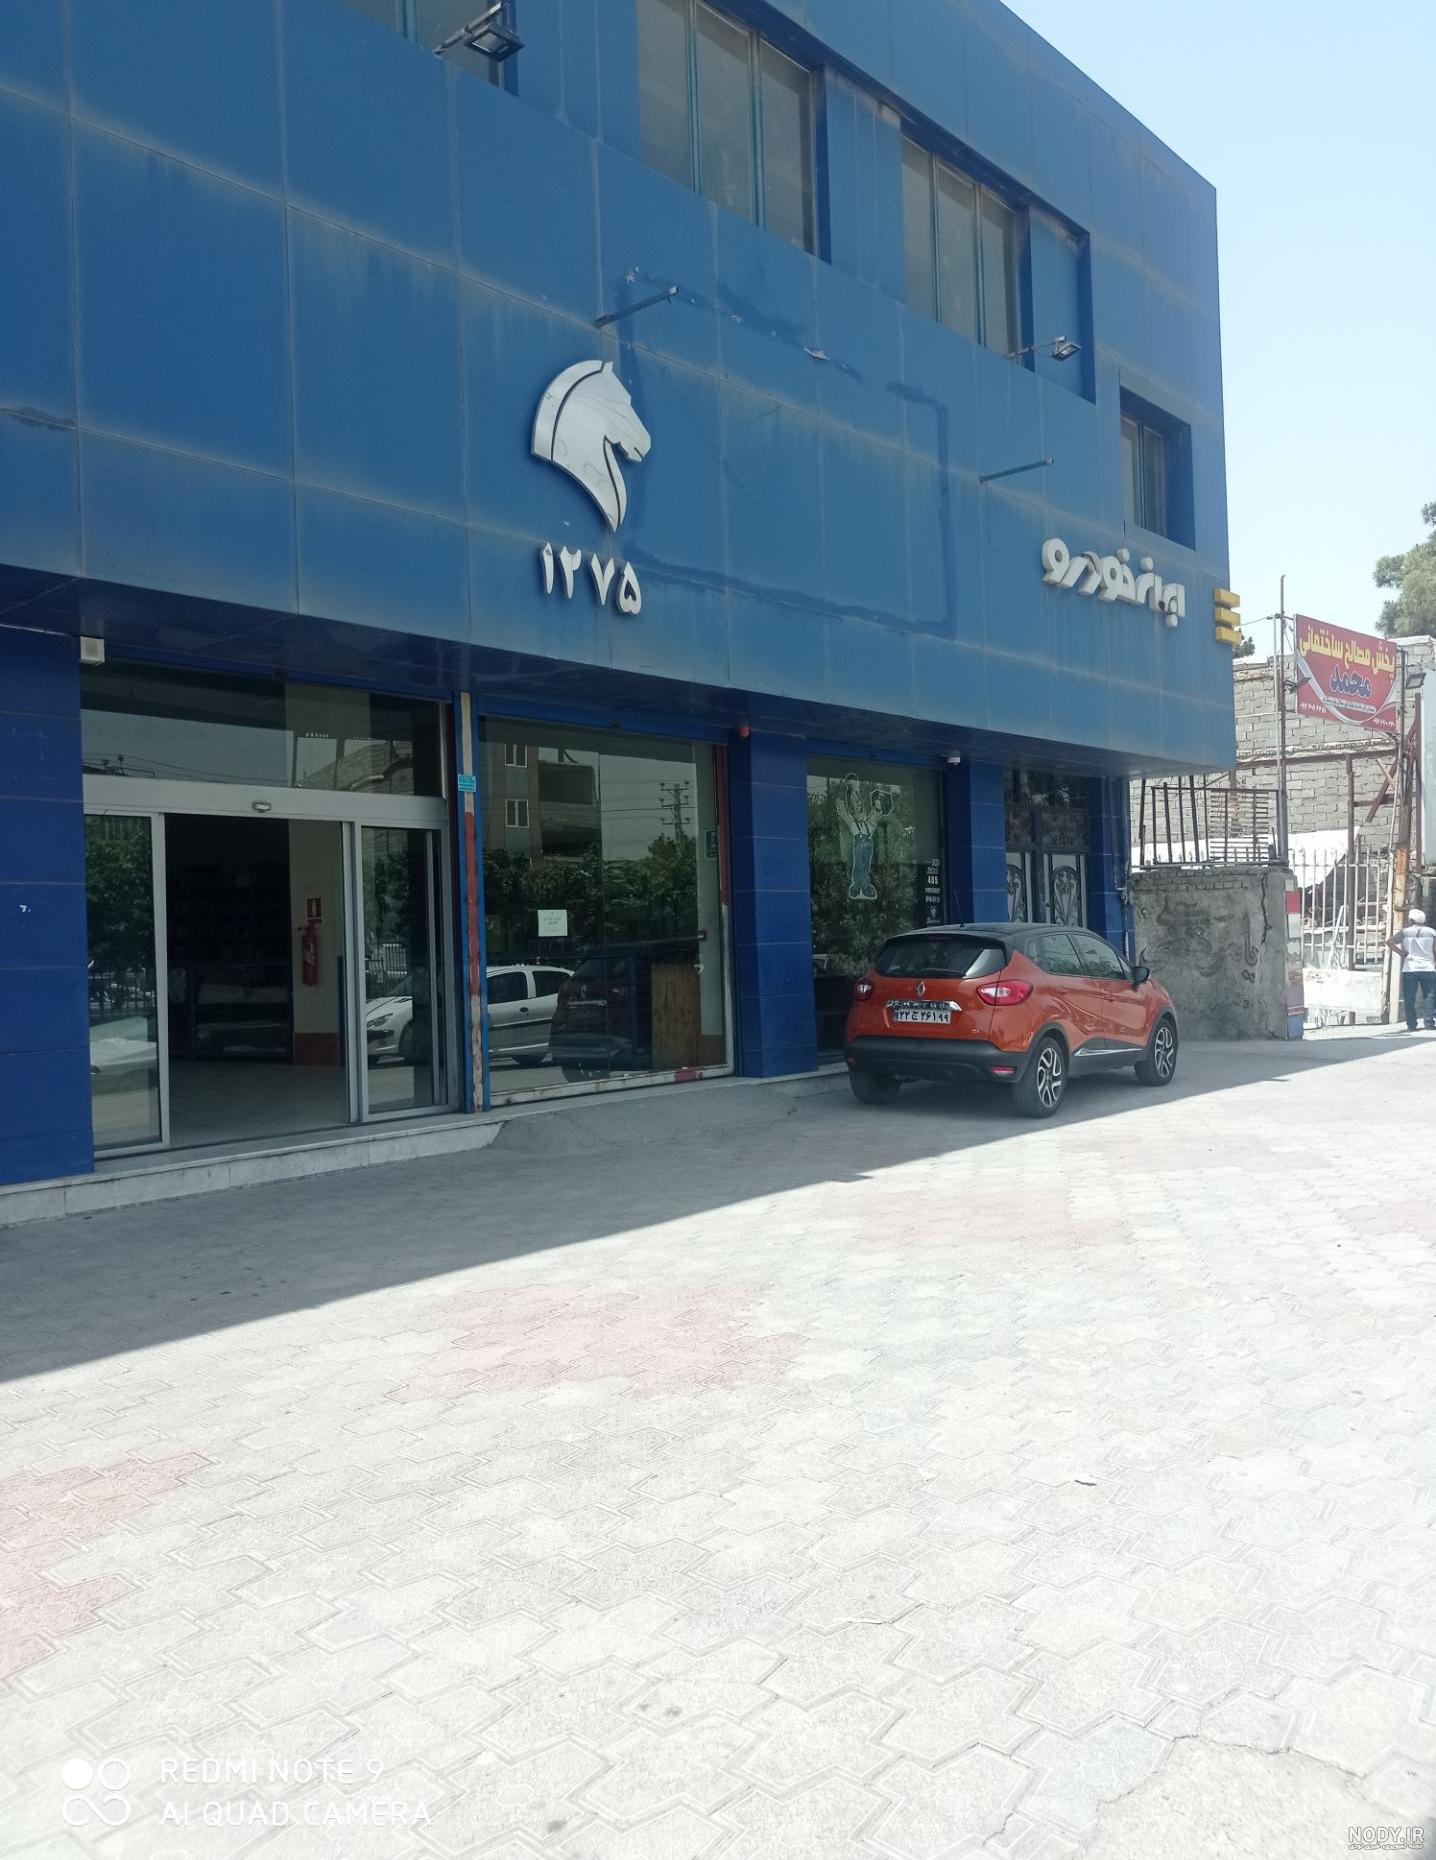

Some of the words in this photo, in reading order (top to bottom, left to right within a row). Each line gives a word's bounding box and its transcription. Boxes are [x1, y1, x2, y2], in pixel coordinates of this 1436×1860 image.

[542, 542, 642, 615] ۱۲۷۵
[1300, 625, 1343, 659] ساختمانی
[1344, 640, 1371, 670] مصالح
[1371, 640, 1396, 684] پخش
[1330, 664, 1372, 699] محمد
